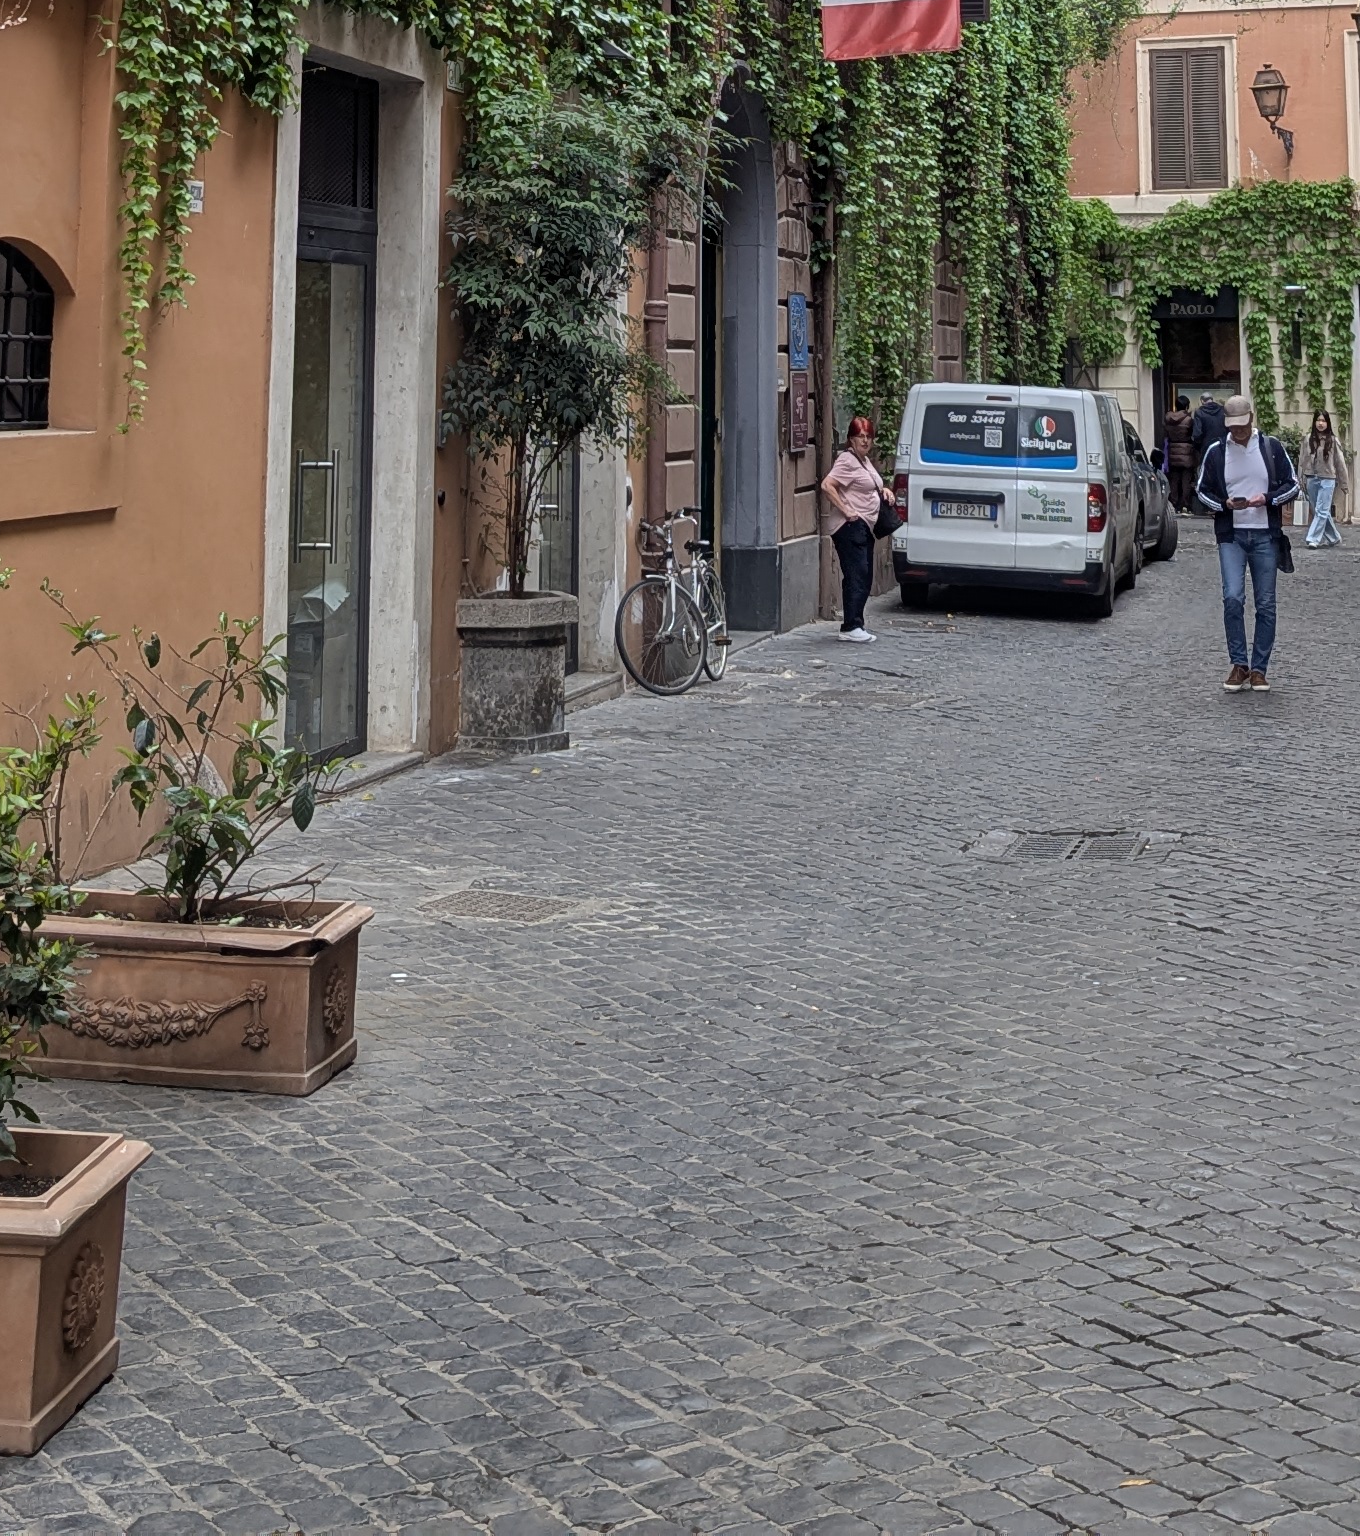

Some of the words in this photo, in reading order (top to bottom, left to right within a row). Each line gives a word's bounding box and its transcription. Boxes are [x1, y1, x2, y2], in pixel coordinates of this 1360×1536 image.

[1169, 302, 1215, 315] PAOLO
[949, 414, 967, 423] 800
[970, 415, 1005, 425] 334440
[1021, 437, 1044, 451] Sicily
[1044, 438, 1056, 451] by
[1056, 439, 1073, 451] Car
